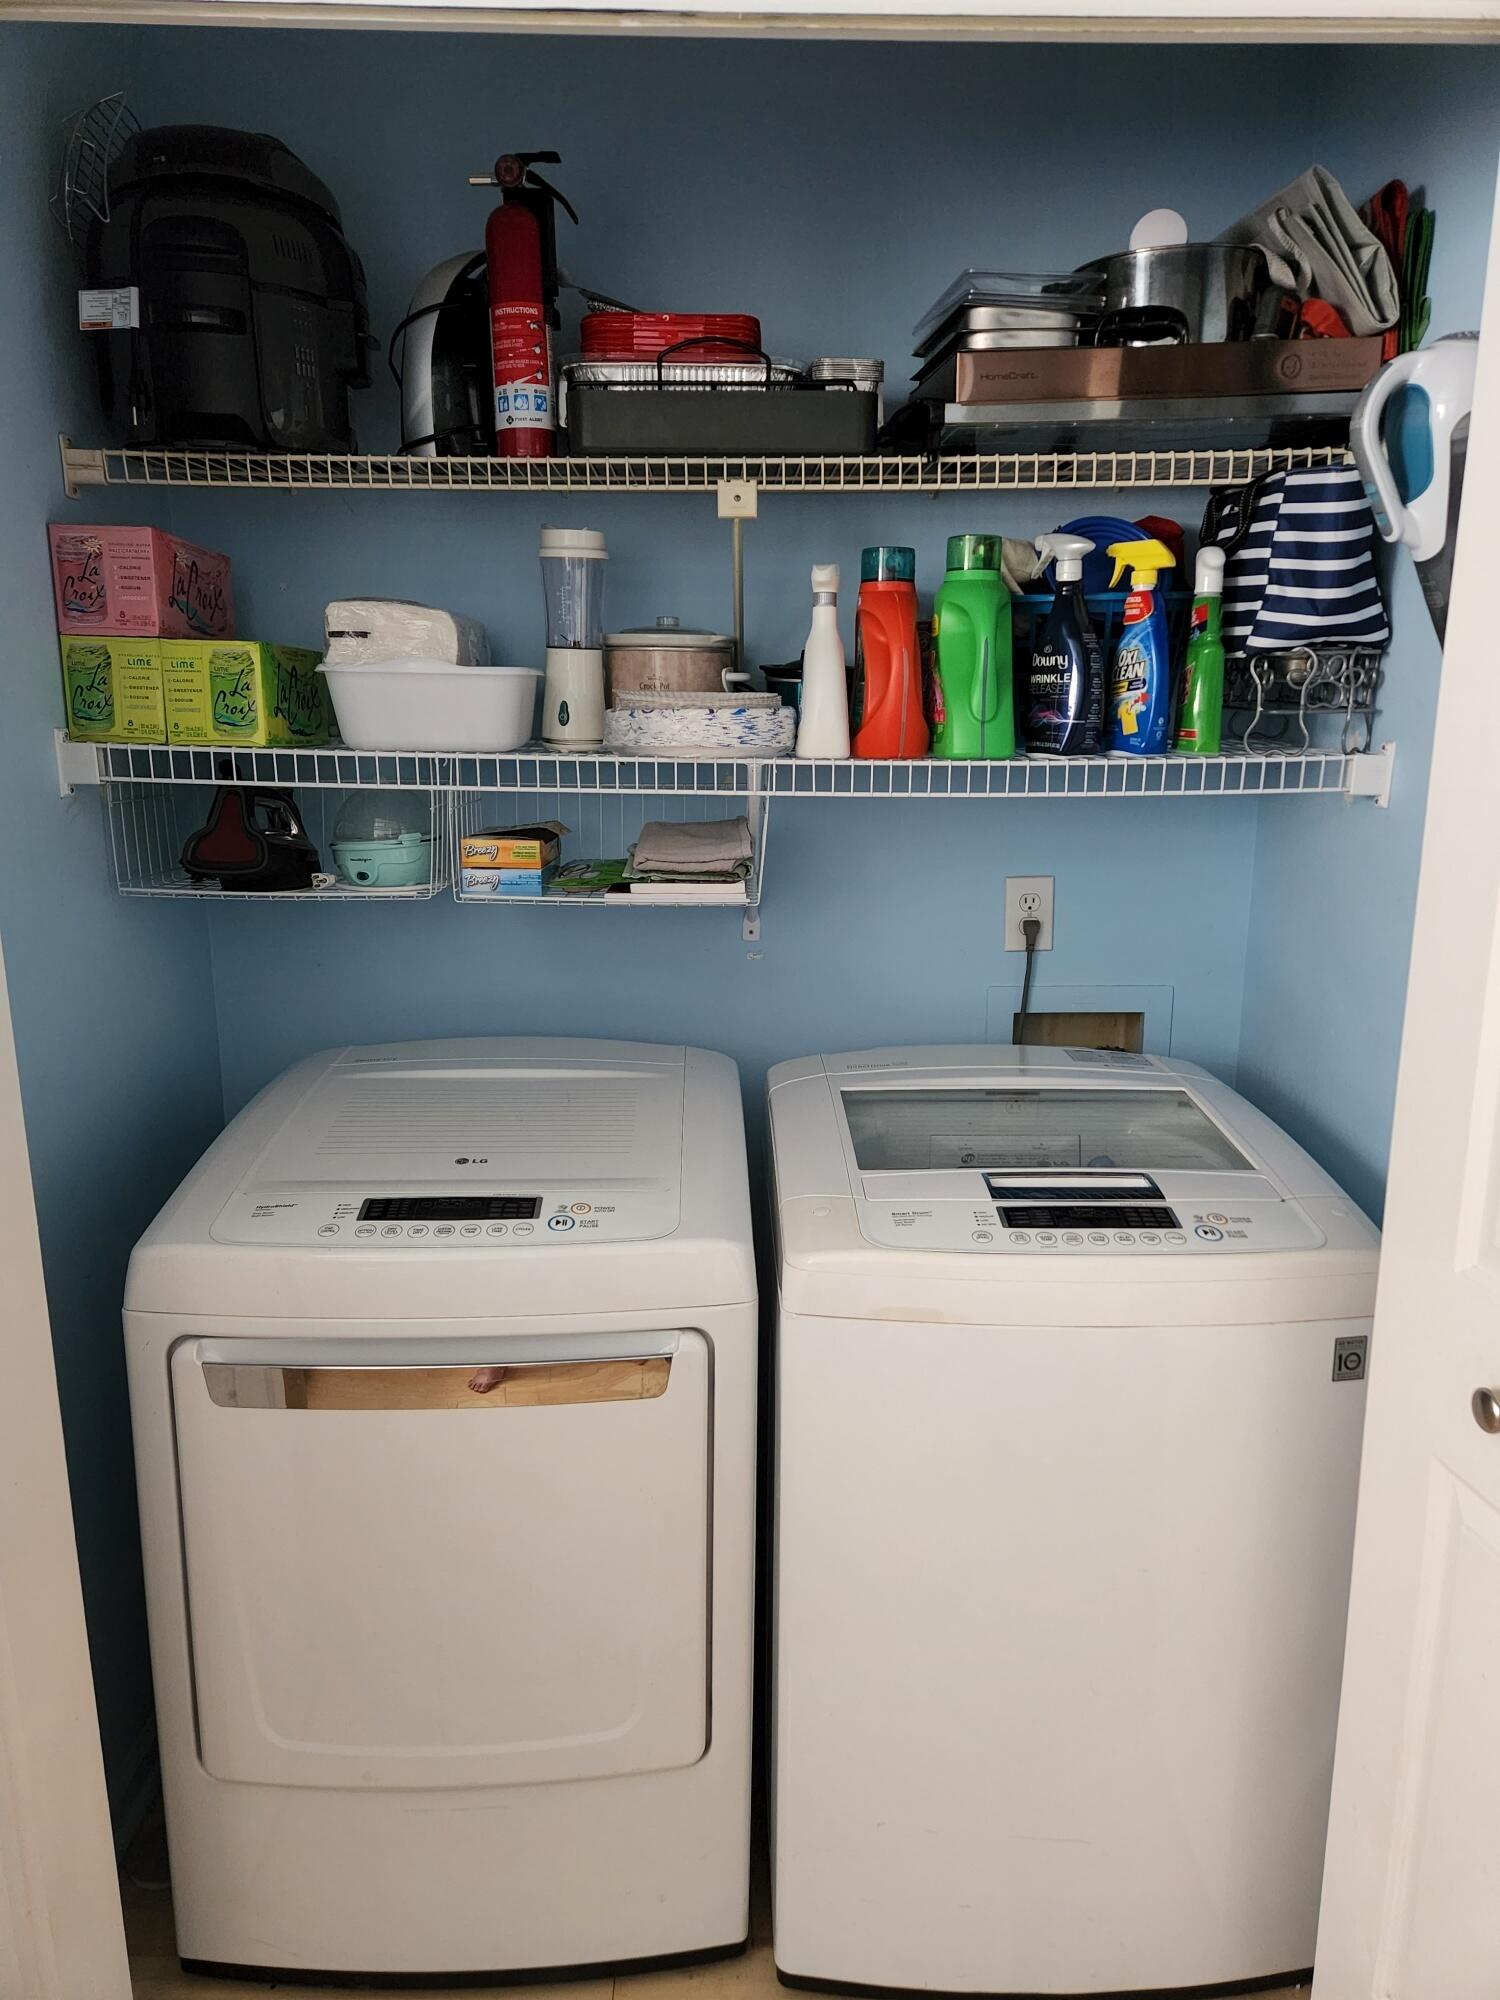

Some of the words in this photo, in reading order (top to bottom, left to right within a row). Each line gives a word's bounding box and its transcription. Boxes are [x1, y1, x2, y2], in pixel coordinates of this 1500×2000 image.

[495, 306, 539, 316] INSTRUCTIONS
[127, 658, 153, 667] LIME
[1032, 653, 1069, 670] Downy
[1118, 649, 1139, 664] OXI
[170, 661, 196, 669] LIME
[1030, 672, 1072, 684] WRINKLE
[463, 844, 499, 861] Breezy
[464, 874, 500, 890] Breezy
